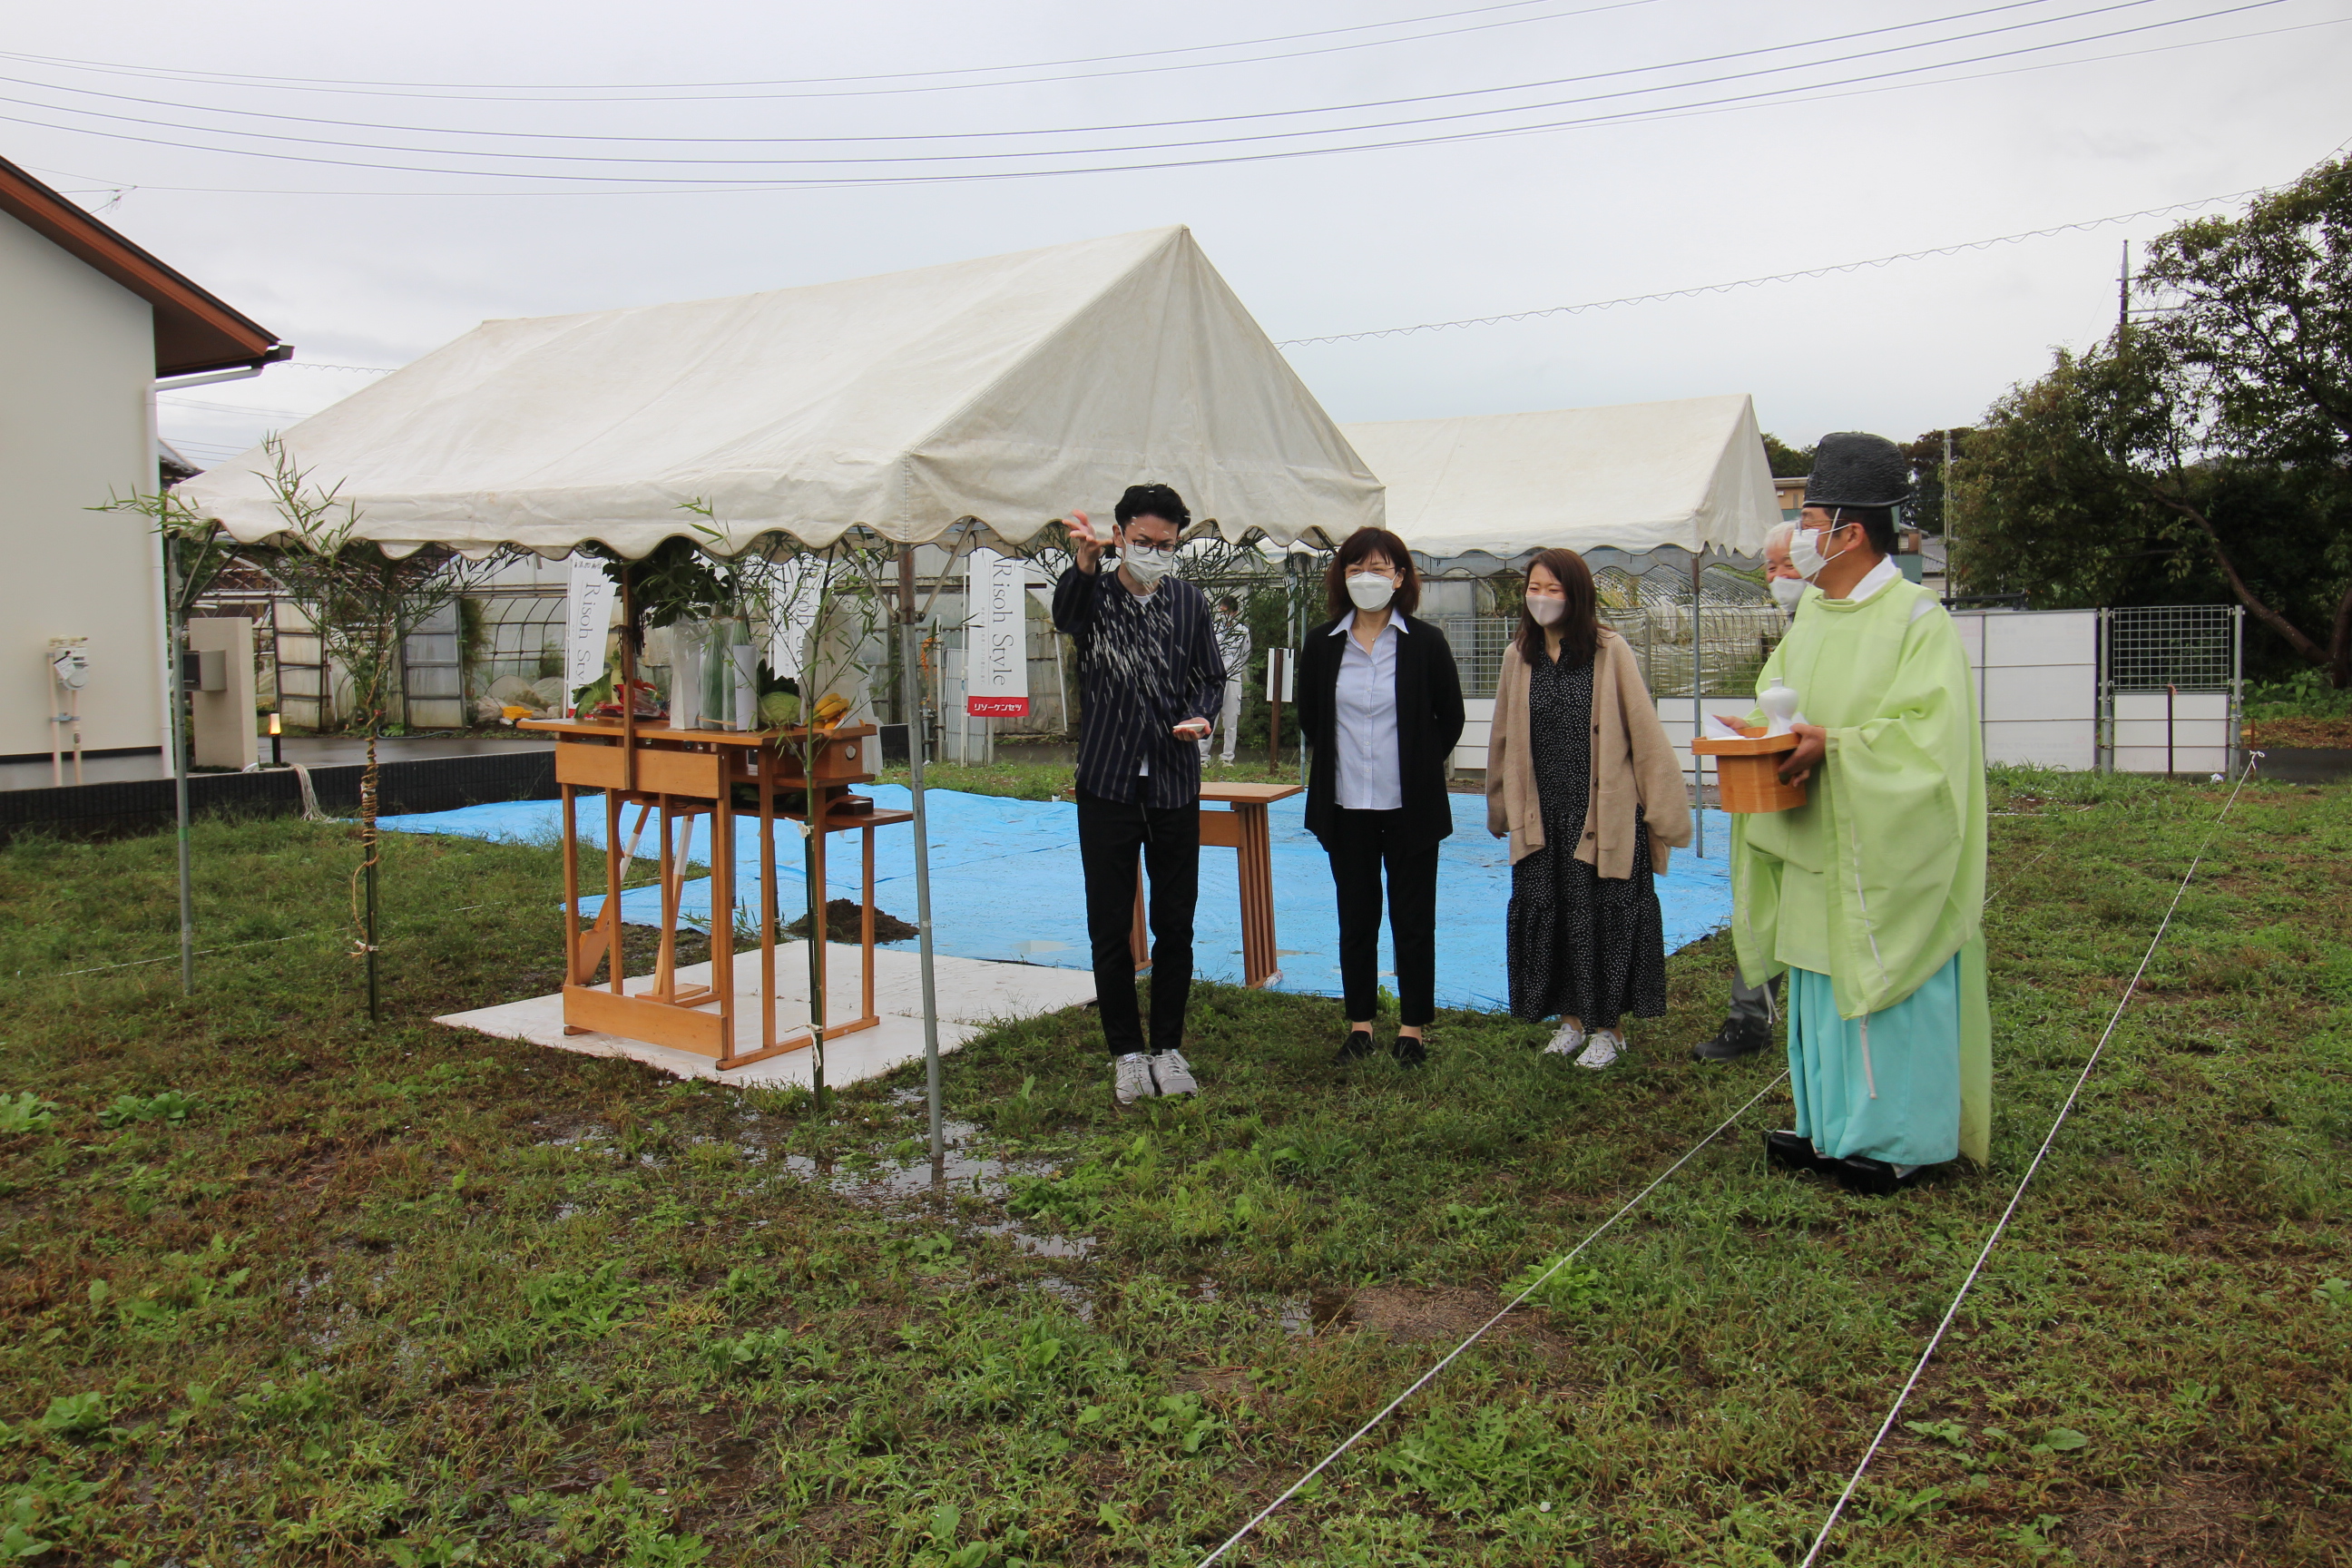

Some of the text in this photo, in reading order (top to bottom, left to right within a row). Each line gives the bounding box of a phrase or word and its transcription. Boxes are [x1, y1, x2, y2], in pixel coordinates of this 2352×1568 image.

[579, 582, 601, 639] Risoh
[989, 563, 1014, 686] Risoh Style
[974, 703, 1023, 711] リソーケンセツ
